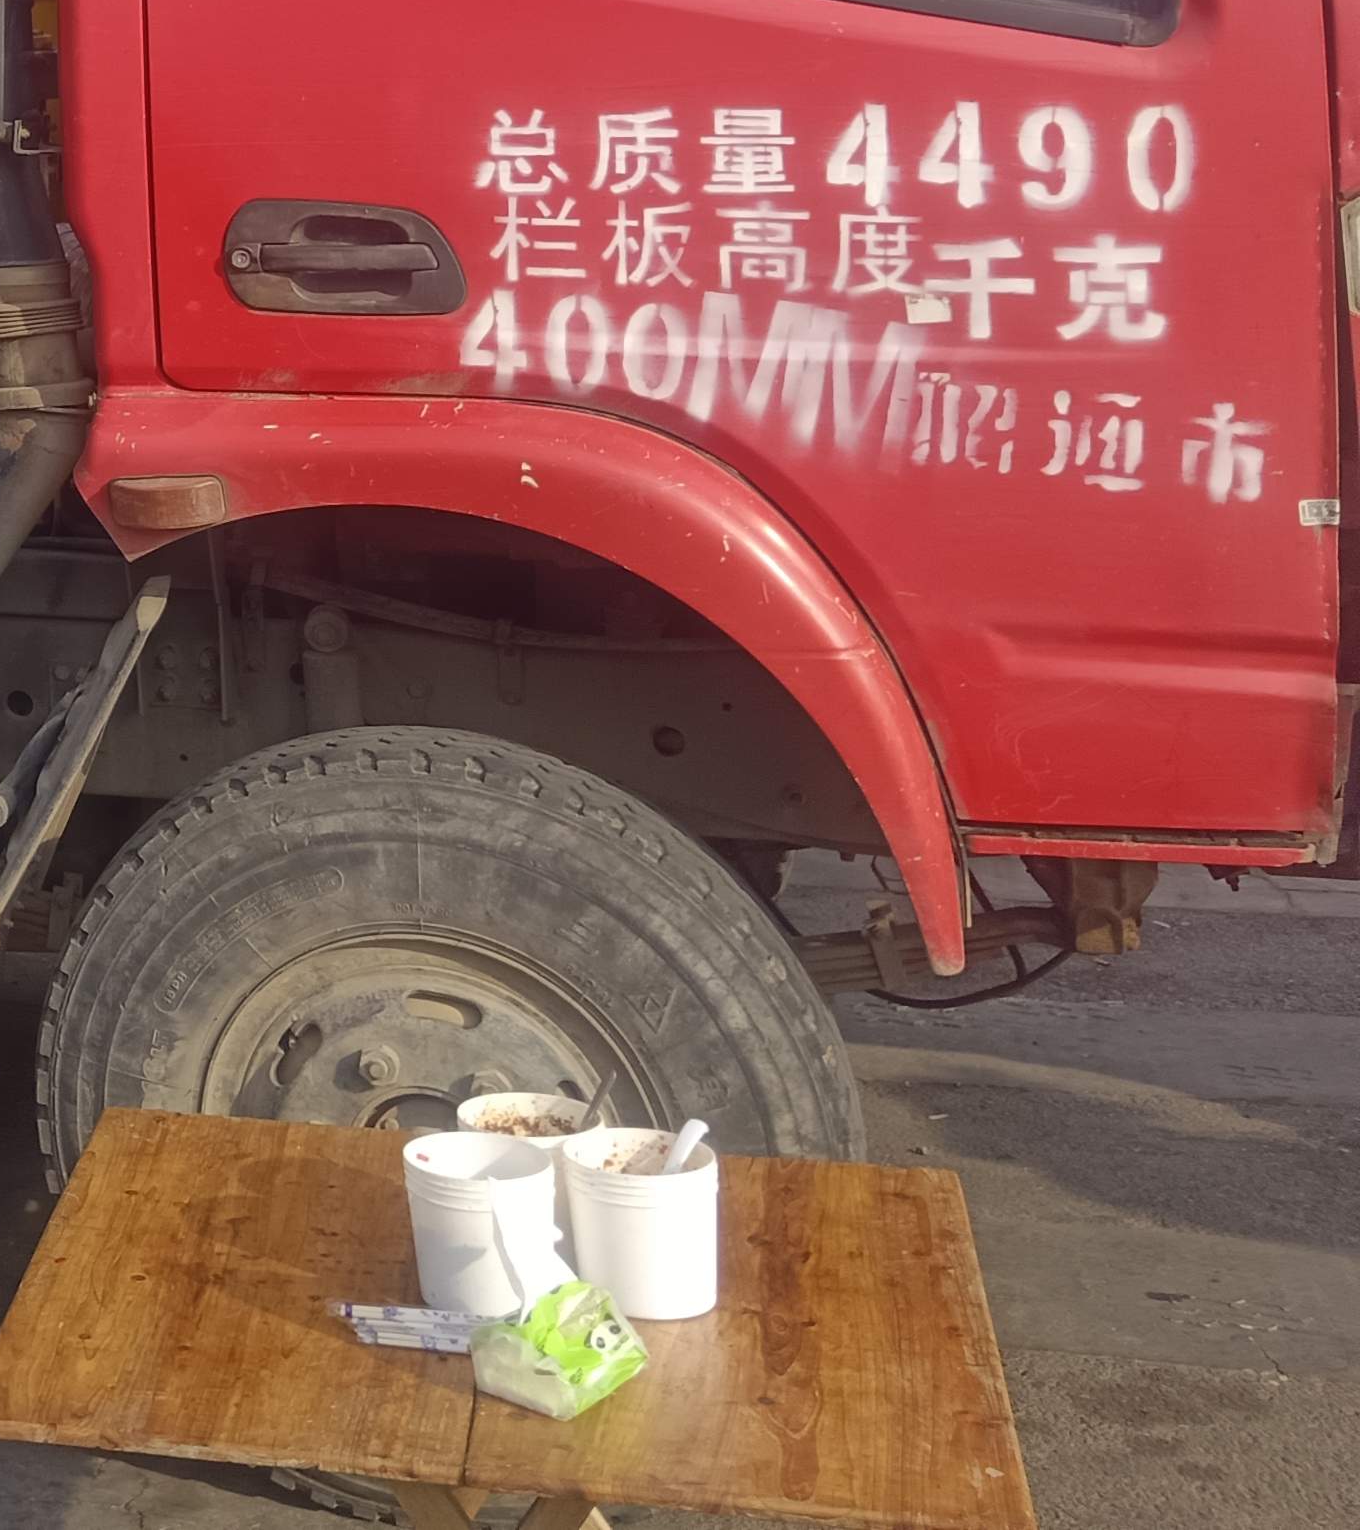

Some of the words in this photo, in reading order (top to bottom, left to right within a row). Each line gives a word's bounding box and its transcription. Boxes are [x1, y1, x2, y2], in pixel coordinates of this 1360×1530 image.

[476, 99, 1198, 213] 总质量4490
[487, 196, 924, 296] 栏板高度
[924, 233, 1168, 342] 千克
[460, 288, 928, 460] 400MM
